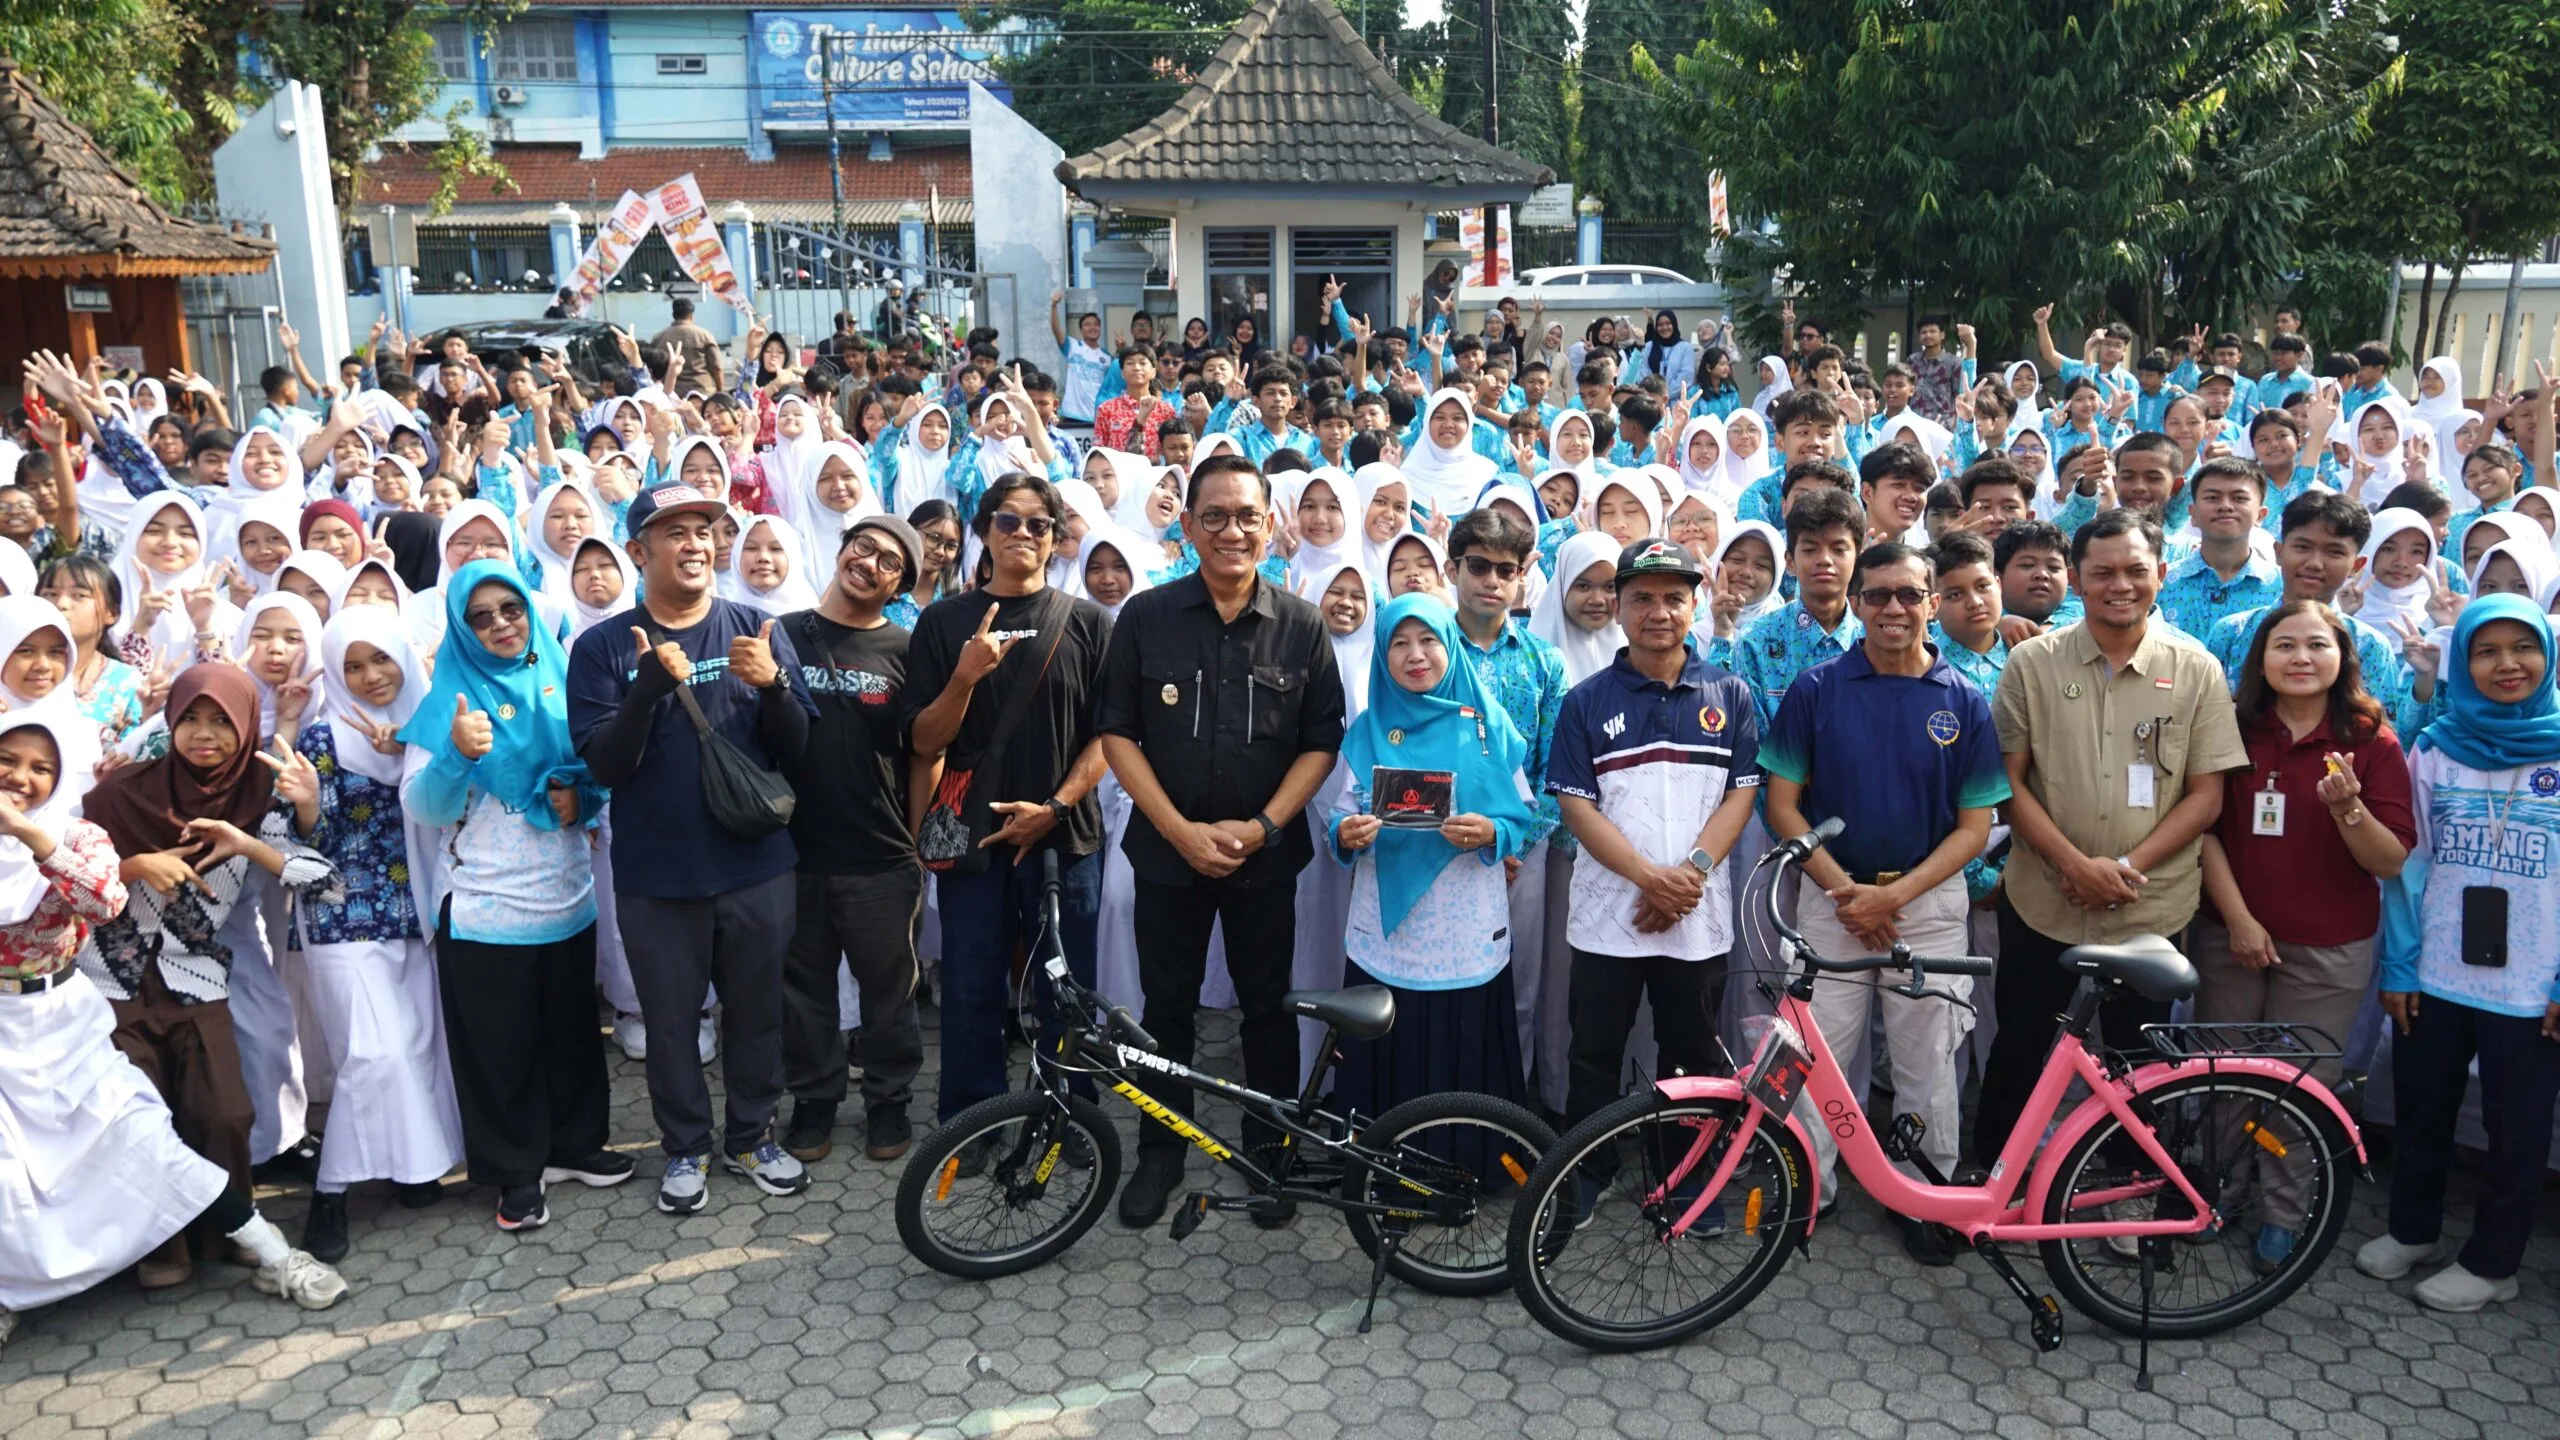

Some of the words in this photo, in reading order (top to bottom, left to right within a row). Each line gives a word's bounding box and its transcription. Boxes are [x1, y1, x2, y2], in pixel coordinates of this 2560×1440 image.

[808, 24, 857, 53] The
[1602, 711, 1626, 740] YK
[1561, 785, 1597, 801] JOGJA
[2525, 831, 2549, 863] 6
[1112, 1080, 1233, 1162] PACIFIC
[1780, 1146, 1799, 1189] KENDA
